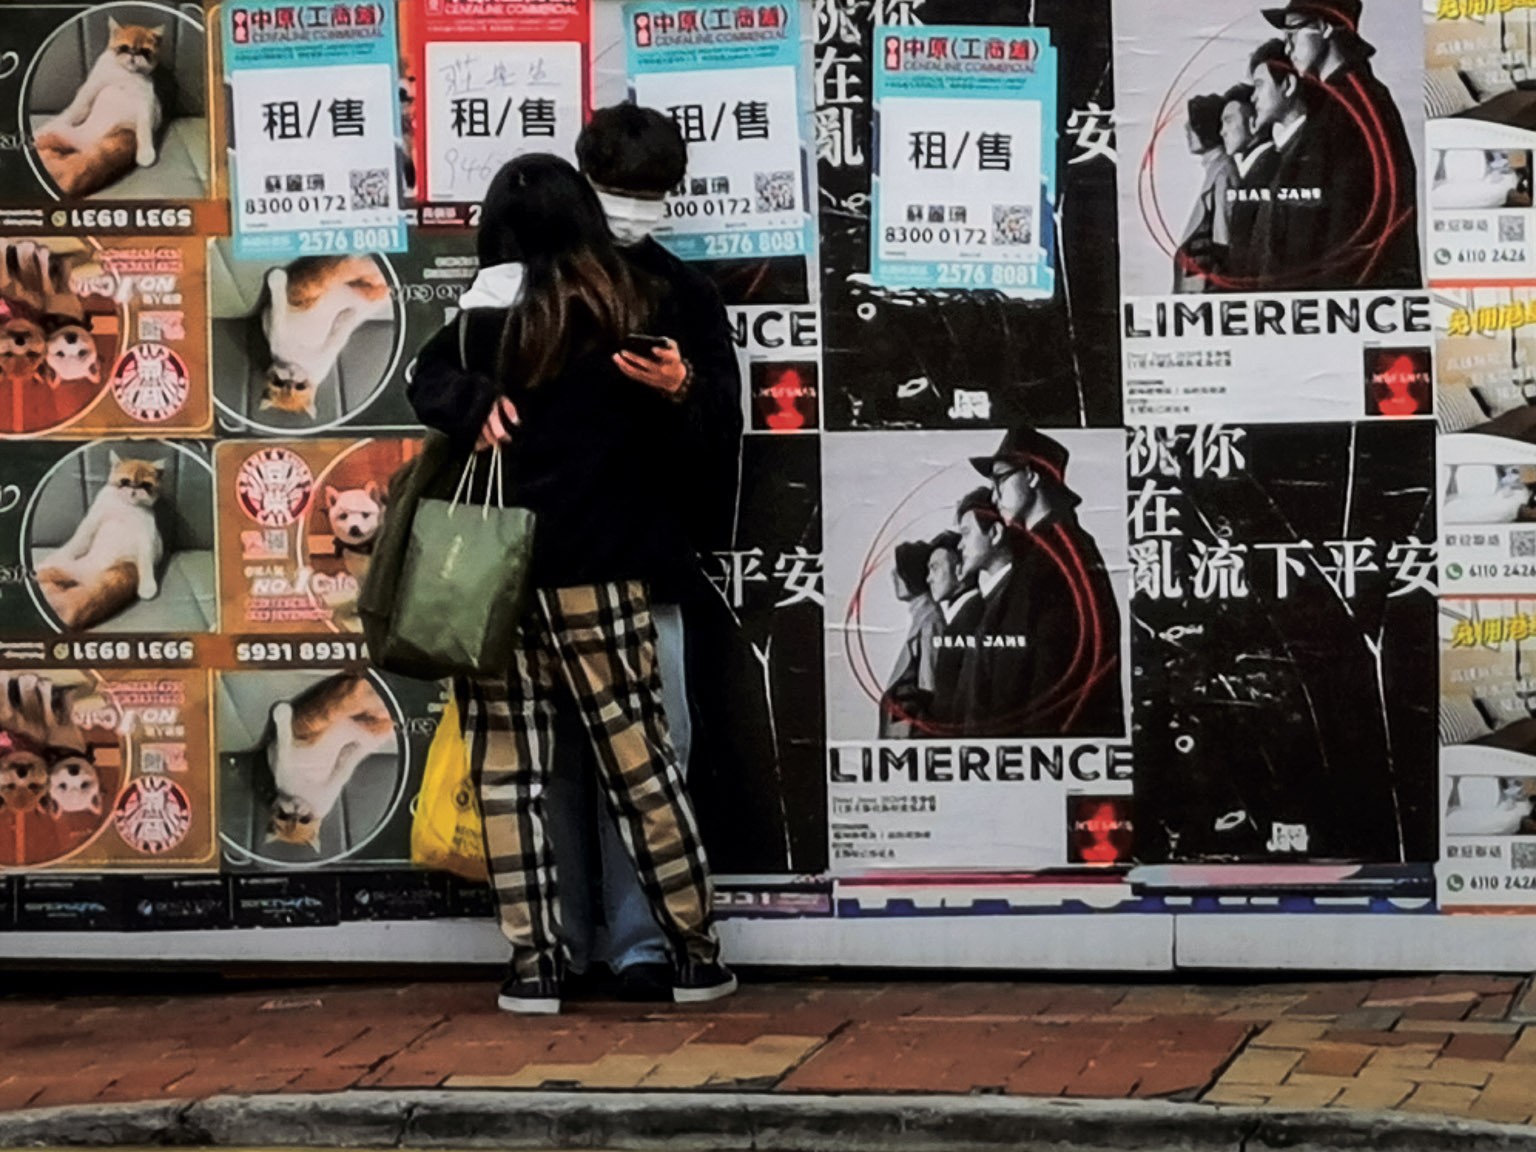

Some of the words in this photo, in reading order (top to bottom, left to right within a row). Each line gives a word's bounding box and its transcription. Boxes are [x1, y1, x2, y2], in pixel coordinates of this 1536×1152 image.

[813, 47, 864, 106] 在
[263, 97, 365, 141] 租/售
[450, 97, 556, 138] 租/售
[909, 131, 1013, 172] 租/售
[246, 199, 293, 215] 8300
[298, 197, 346, 213] 0172
[709, 199, 751, 216] 0172
[300, 231, 348, 251] 2576
[354, 229, 400, 249] 8081
[704, 234, 752, 253] 2576
[759, 230, 804, 251] 8081
[885, 228, 933, 244] 8300
[939, 228, 987, 244] 0172
[1457, 249, 1486, 263] 6110
[1491, 248, 1526, 263] 2426
[937, 263, 986, 284] 2576
[992, 263, 1038, 285] 8081
[1124, 295, 1432, 339] LIMERENCE
[1128, 479, 1183, 540] 在
[1127, 538, 1438, 600] 亂流下平安
[1469, 564, 1497, 578] 6110
[1503, 563, 1536, 578] 2426
[236, 643, 292, 660] 5931
[299, 642, 357, 660] 8931
[828, 744, 1135, 783] LIMERENCE
[1471, 876, 1499, 890] 6110
